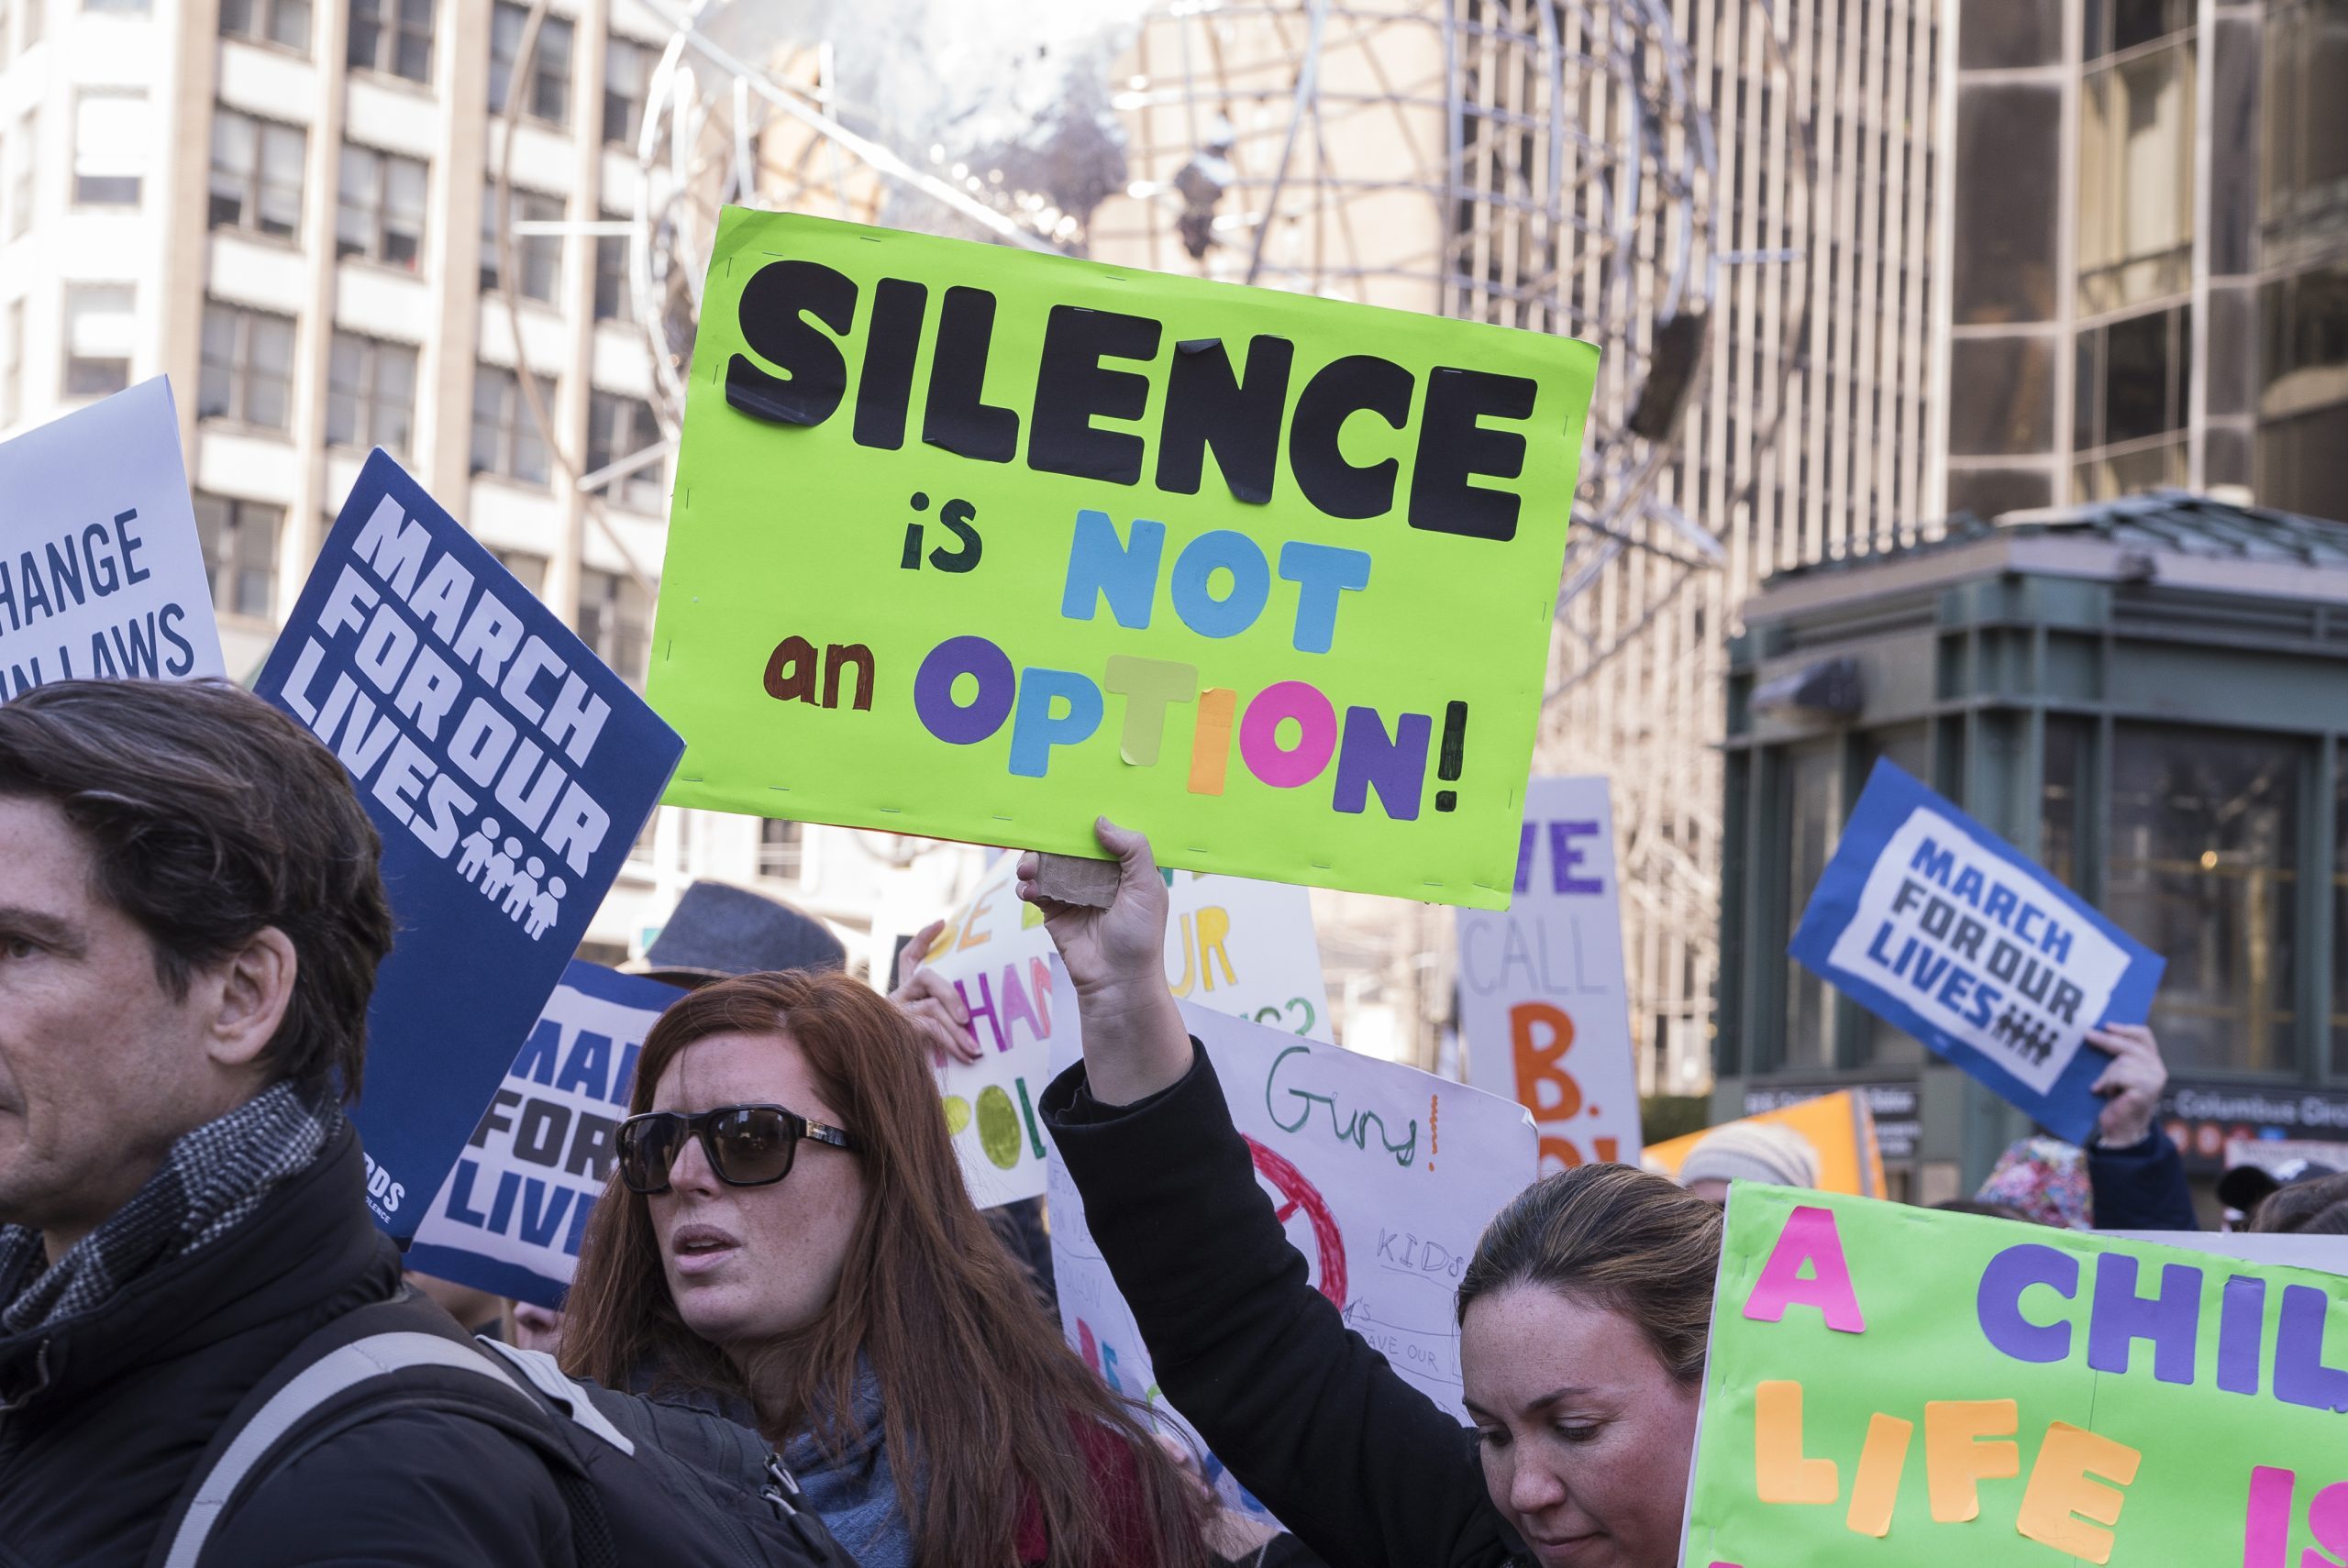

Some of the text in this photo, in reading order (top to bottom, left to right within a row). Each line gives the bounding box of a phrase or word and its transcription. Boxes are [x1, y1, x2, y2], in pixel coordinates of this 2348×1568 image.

[724, 259, 1538, 542] SILENCE
[351, 492, 612, 767] MARCH
[900, 492, 1372, 654] is NOT
[281, 635, 477, 859] LIVES
[317, 562, 611, 878] FOR OUR
[763, 635, 1468, 822] an OPTION!
[1463, 917, 1609, 999] CALL
[1890, 878, 2086, 1025] FOR OUR
[1909, 836, 2075, 965] MARCH
[1866, 921, 2003, 1032] LIVES
[1509, 1000, 1601, 1124] B.
[2175, 1088, 2296, 1126] Columbus
[1743, 1206, 1866, 1334] A
[1408, 1344, 1439, 1373] OUR
[1755, 1380, 2143, 1565] LIFE
